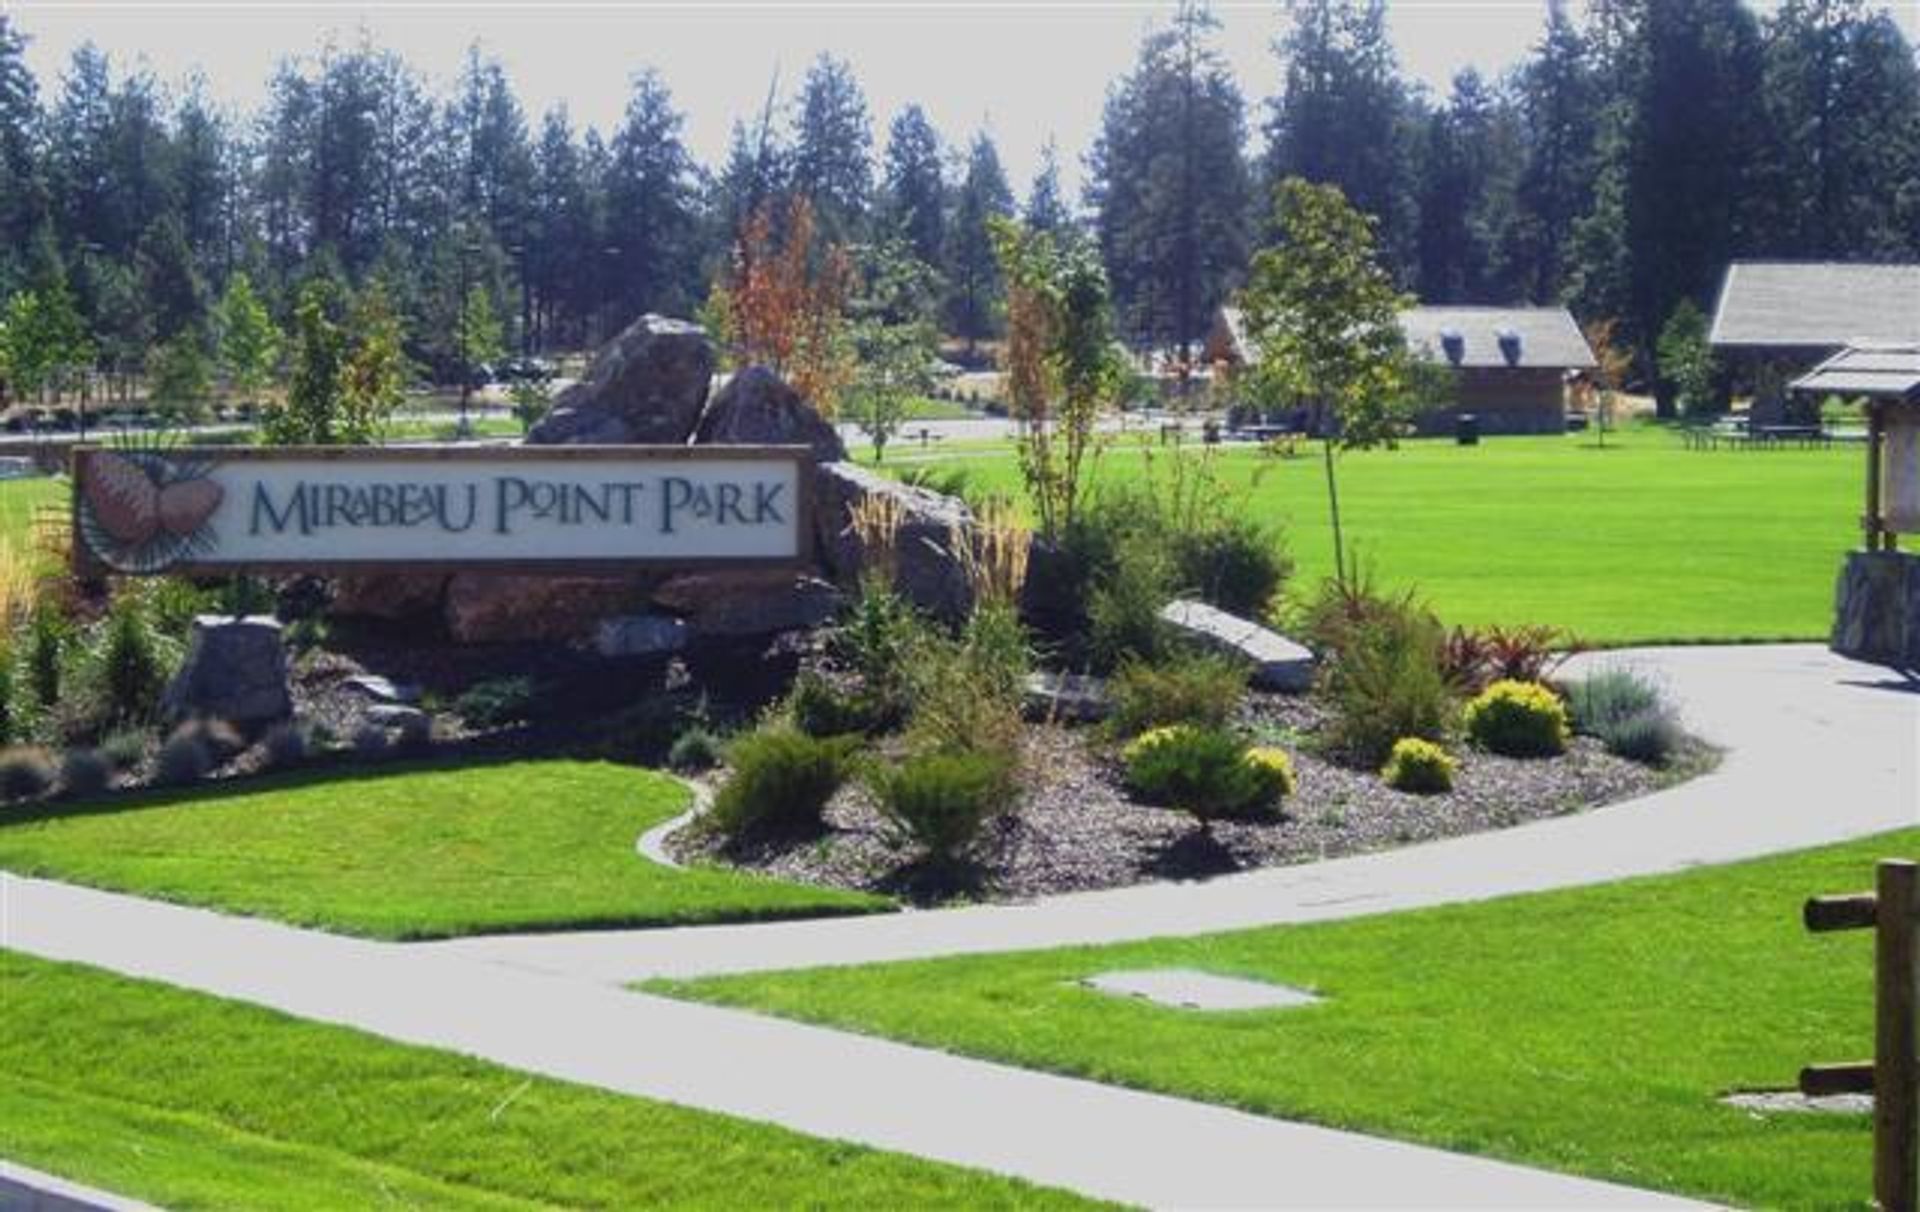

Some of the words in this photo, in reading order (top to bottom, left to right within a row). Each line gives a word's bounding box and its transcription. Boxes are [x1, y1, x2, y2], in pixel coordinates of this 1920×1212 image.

[249, 480, 478, 535] MIRABEAU
[495, 478, 643, 535] POINT
[660, 477, 786, 533] PARK
